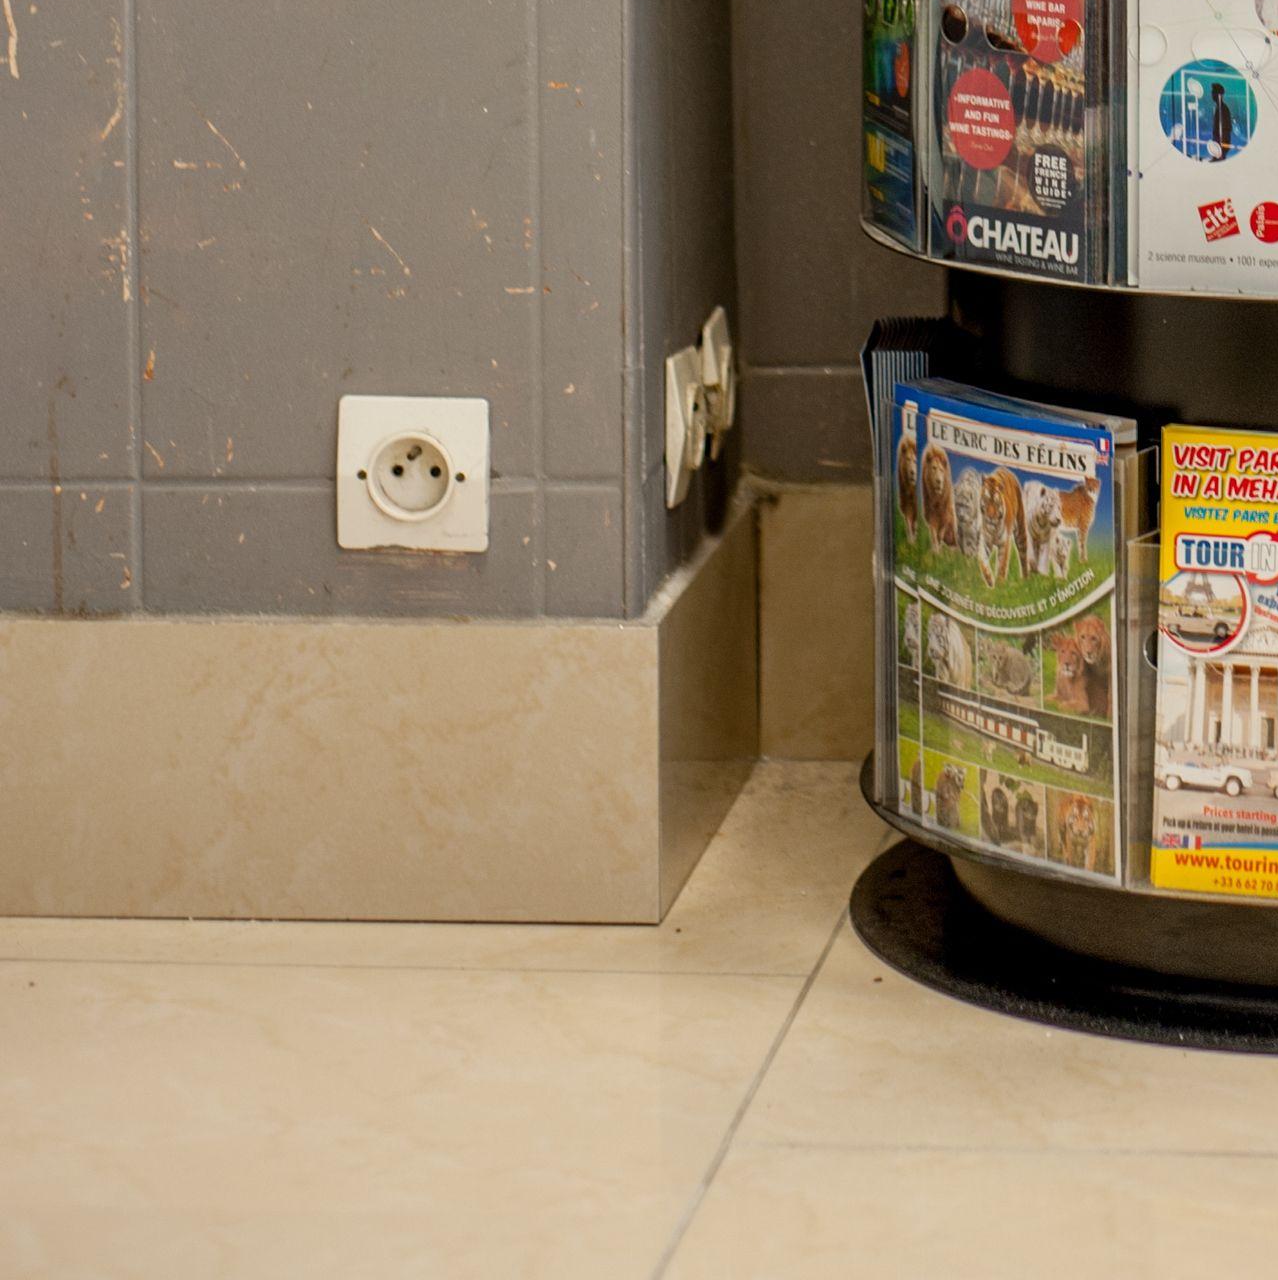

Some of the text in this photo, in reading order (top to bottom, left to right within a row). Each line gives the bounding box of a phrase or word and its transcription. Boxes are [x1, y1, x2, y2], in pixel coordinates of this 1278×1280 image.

[1025, 0, 1066, 14] WINE BAR
[964, 110, 999, 124] AND FUN
[1035, 153, 1067, 170] FREE
[1035, 167, 1067, 180] FRENCH
[1202, 197, 1236, 234] cité
[1147, 251, 1153, 262] 2
[1155, 252, 1186, 263] science
[1188, 254, 1227, 265] museums
[1237, 256, 1257, 267] 1001
[931, 422, 1088, 473] LE PARC DES FÉLINS
[1173, 445, 1231, 468] VISIT
[1173, 473, 1197, 495] IN
[1203, 475, 1222, 496] A
[1184, 507, 1229, 520] VISITEZ
[1233, 510, 1270, 524] PARIS
[1182, 538, 1245, 568] TOUR
[1251, 542, 1276, 571] IN
[1203, 805, 1233, 819] Prices
[1236, 808, 1277, 825] starting
